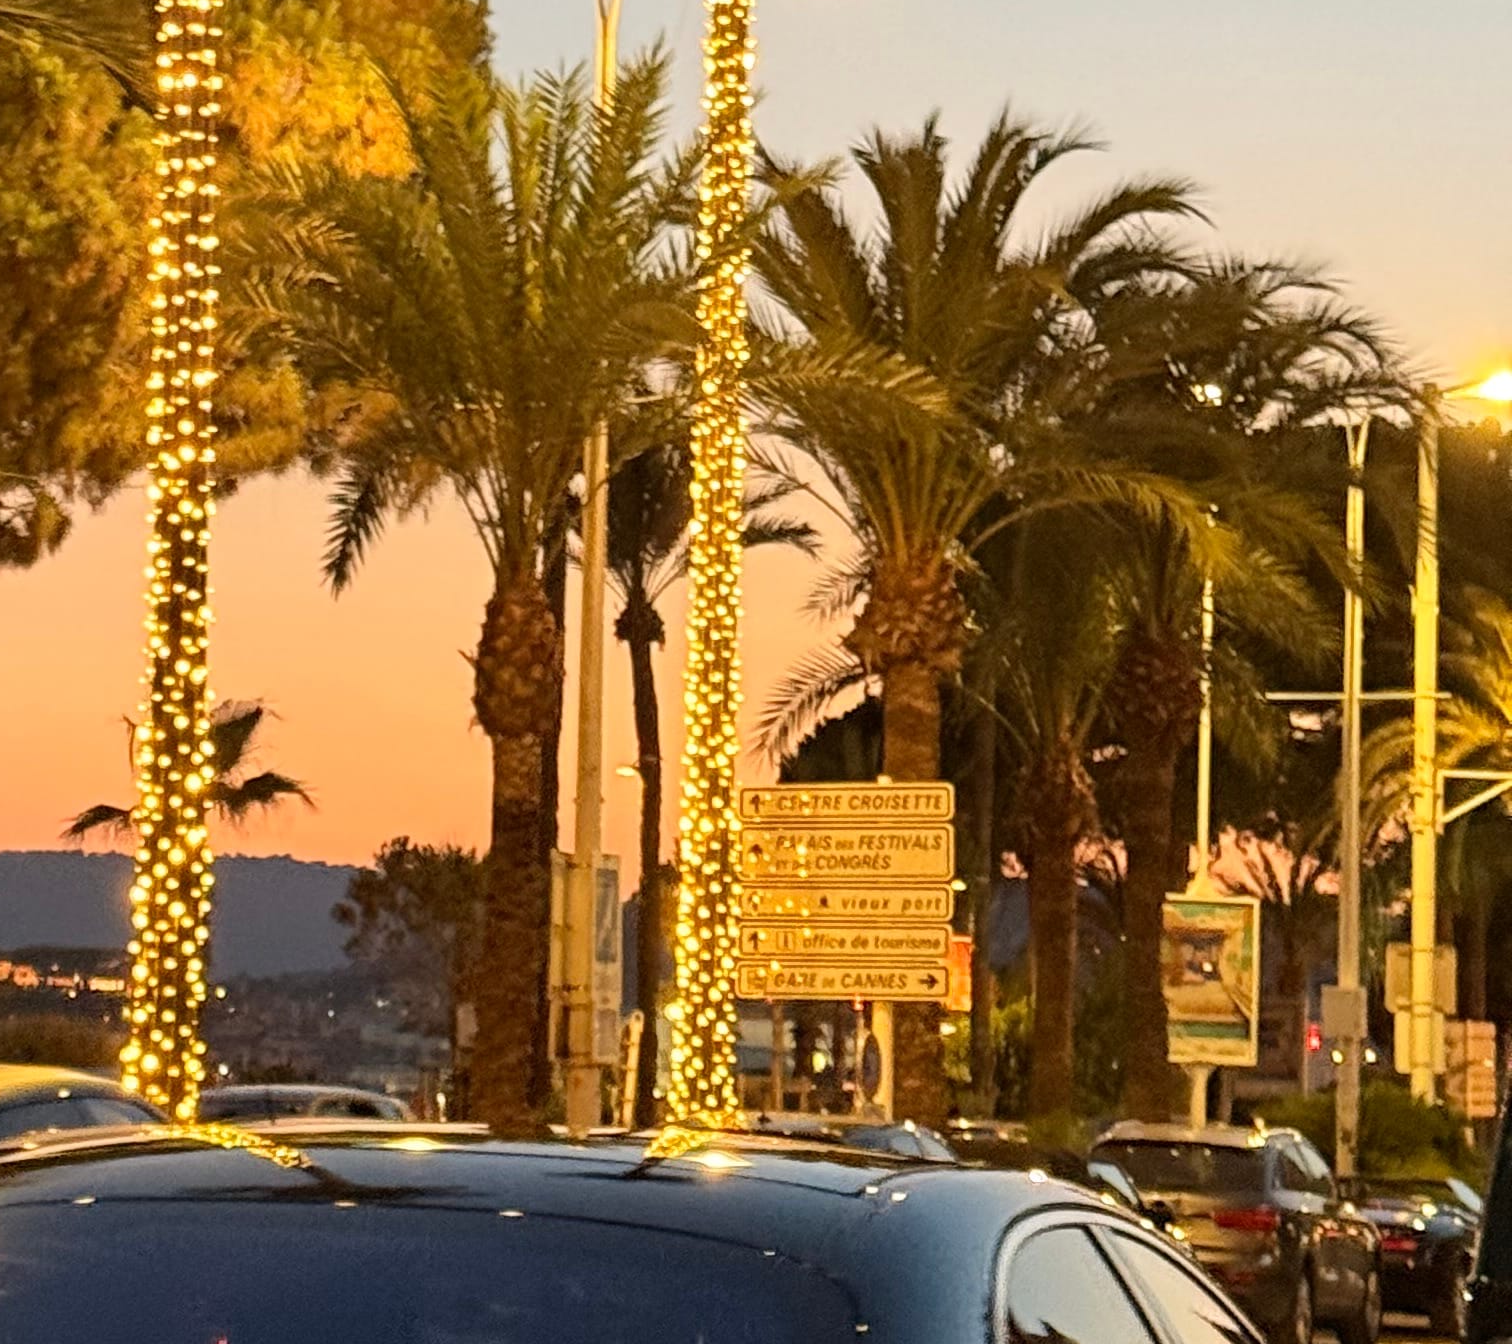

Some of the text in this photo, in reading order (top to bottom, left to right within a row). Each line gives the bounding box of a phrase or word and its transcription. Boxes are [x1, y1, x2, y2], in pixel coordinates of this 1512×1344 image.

[848, 794, 943, 811] CROISETTE
[858, 834, 943, 851] FESTIVALS
[841, 897, 943, 915] vieux port
[802, 933, 846, 950] office
[850, 934, 870, 950] de
[874, 935, 941, 950] tourisme
[840, 972, 908, 990] CANNES
